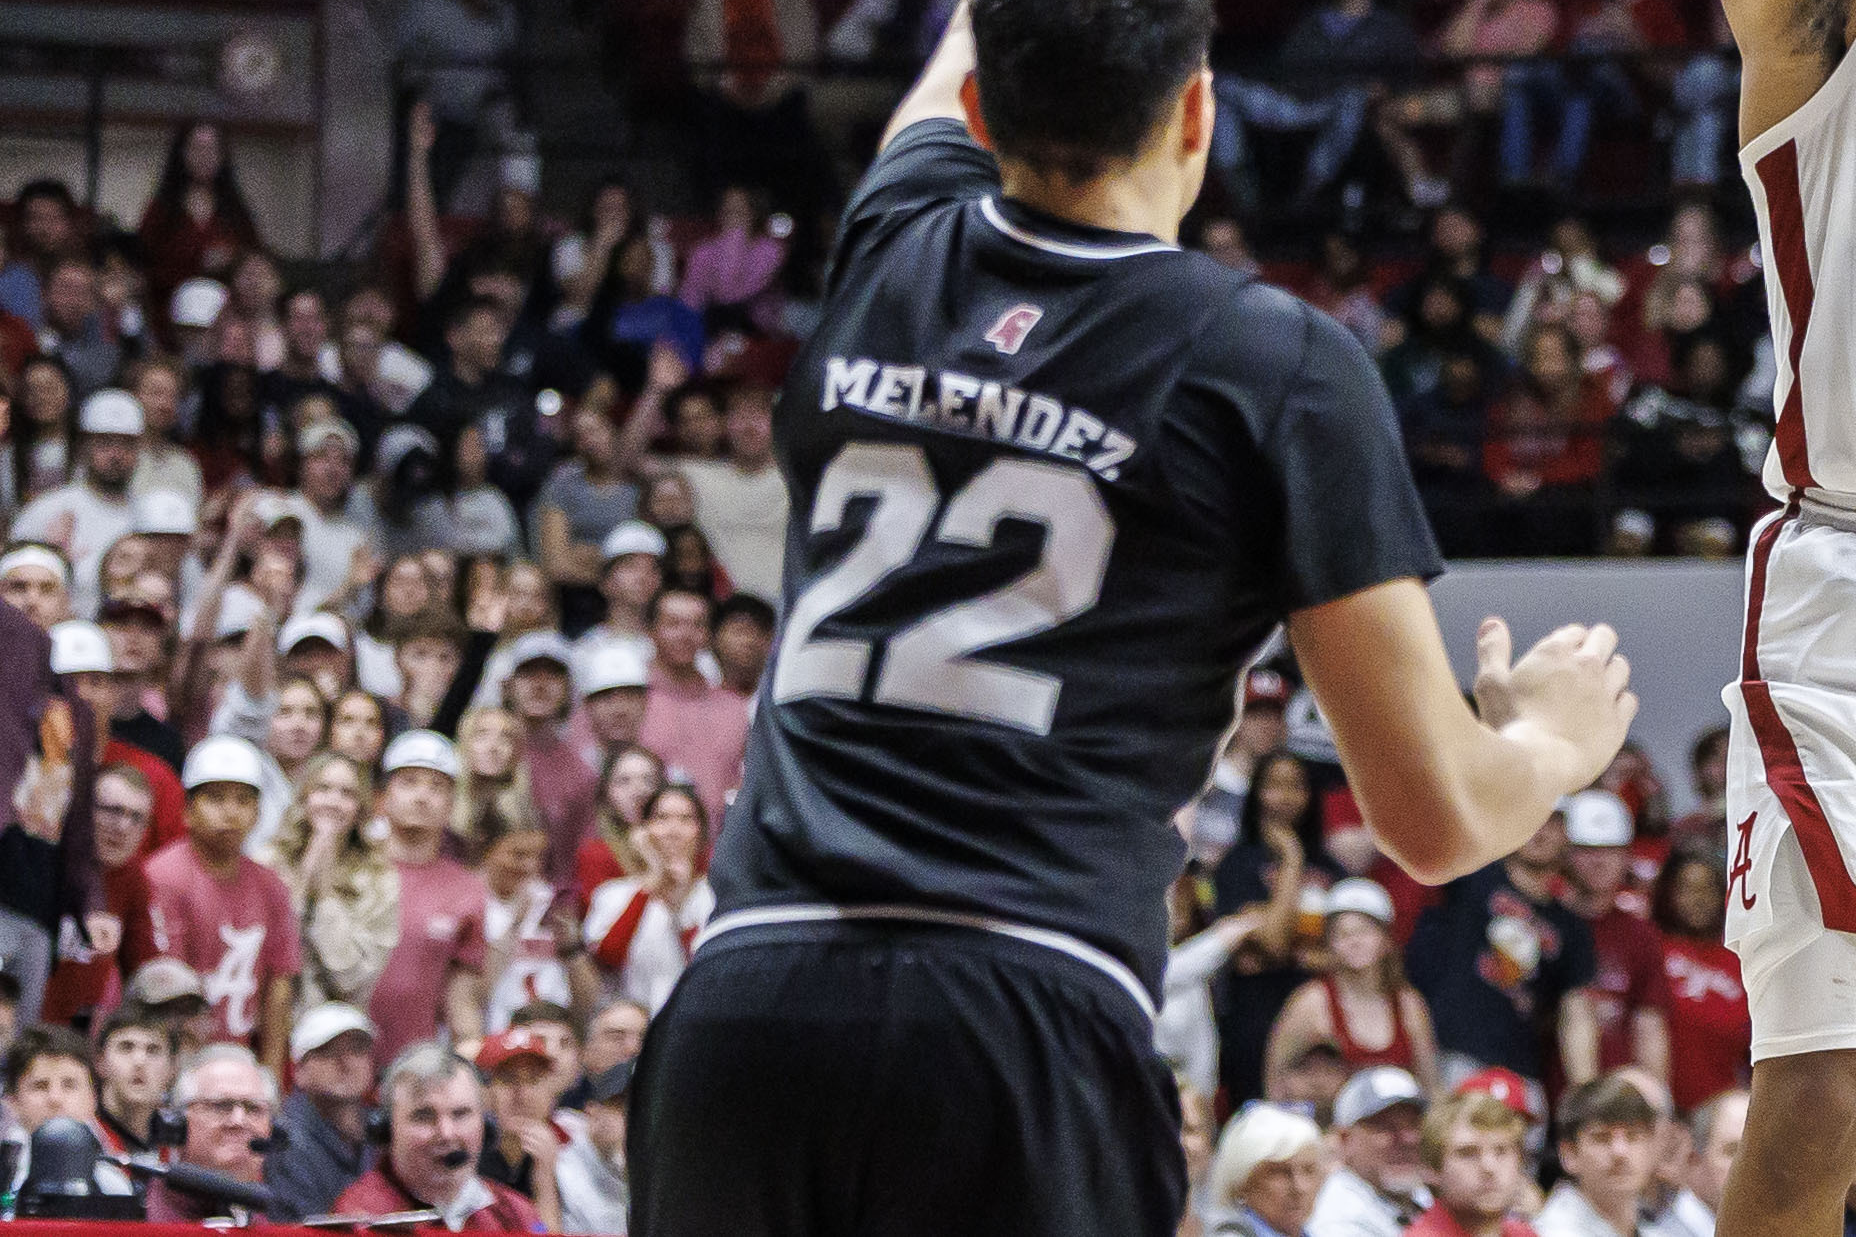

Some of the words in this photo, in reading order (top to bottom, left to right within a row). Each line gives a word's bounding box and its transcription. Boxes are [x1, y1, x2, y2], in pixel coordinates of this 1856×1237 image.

[821, 357, 1138, 483] MELENDEZ
[772, 441, 1118, 737] 22
[1725, 811, 1758, 911] A
